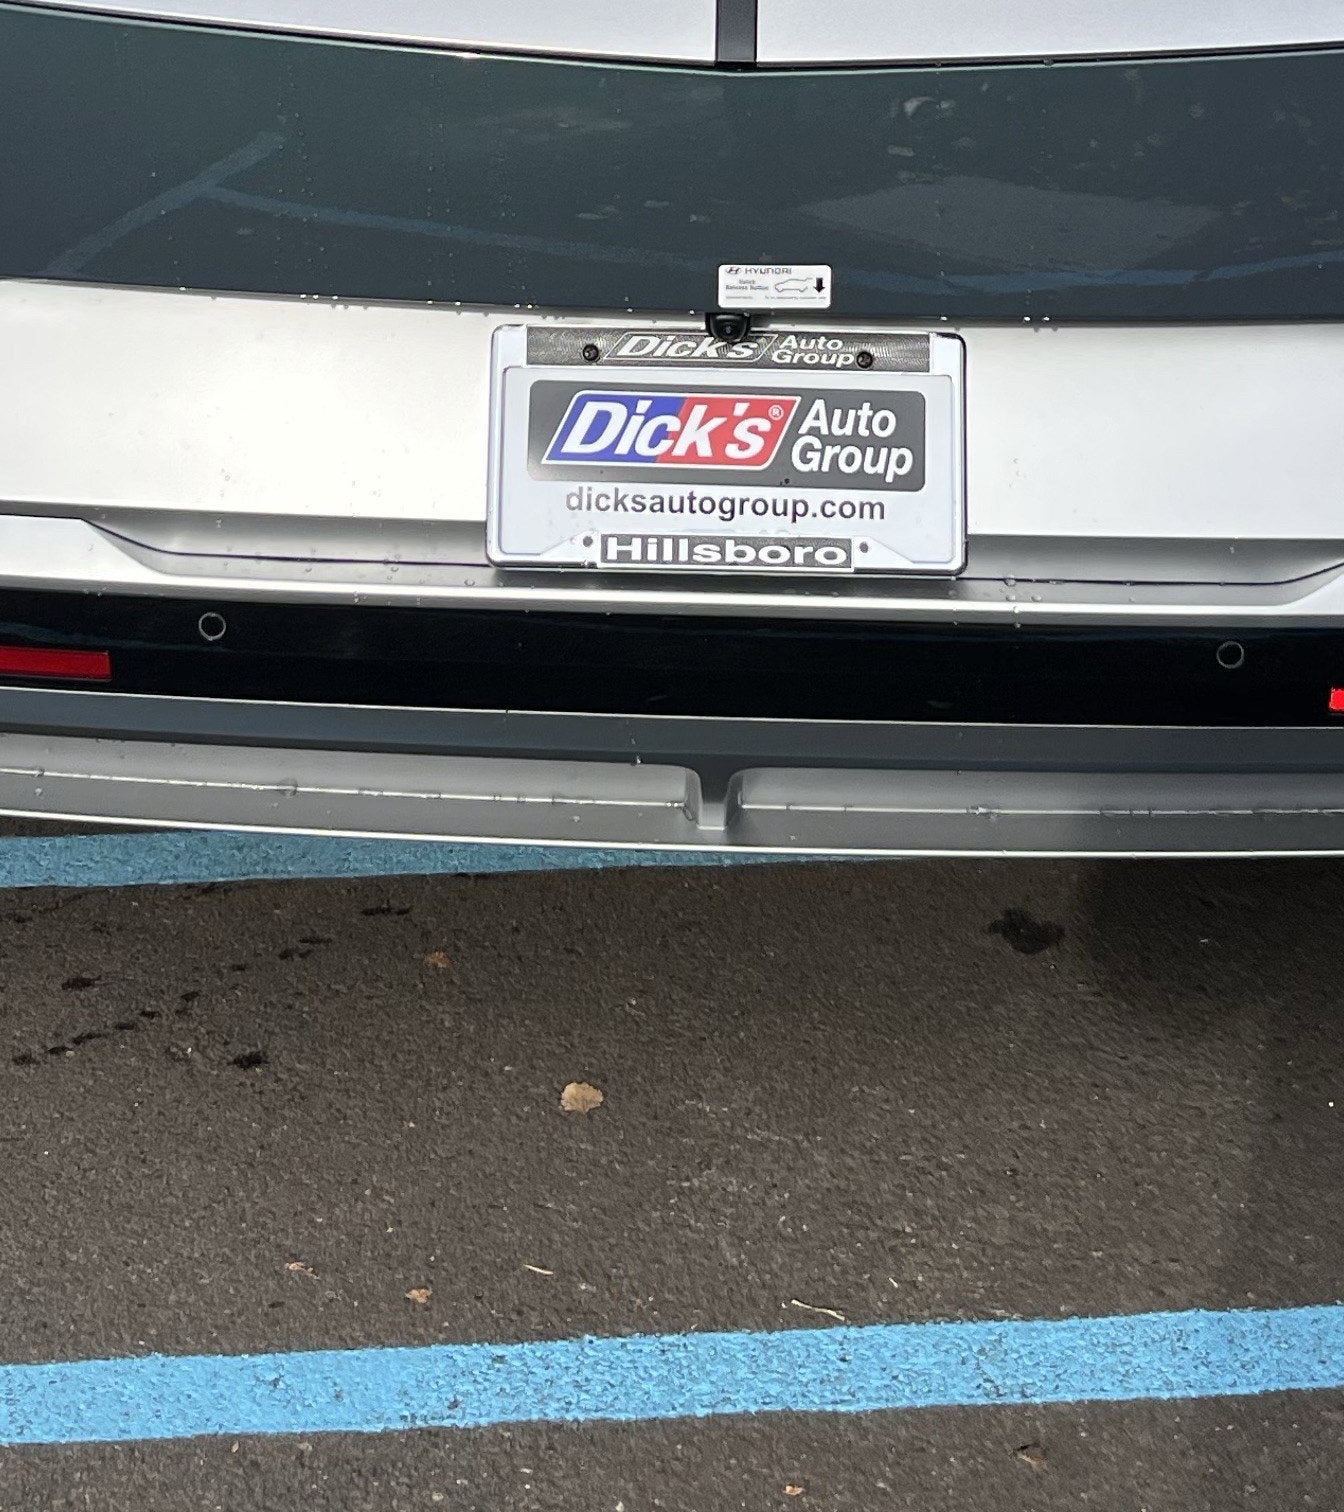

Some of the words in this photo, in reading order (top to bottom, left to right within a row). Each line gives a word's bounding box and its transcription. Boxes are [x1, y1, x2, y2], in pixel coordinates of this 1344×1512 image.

[771, 349, 855, 368] Group
[779, 335, 844, 351] Auto
[798, 399, 897, 438] Auto
[791, 436, 914, 484] Group
[565, 486, 886, 524] dicksautogroup.com
[605, 537, 847, 566] Hillsboro
